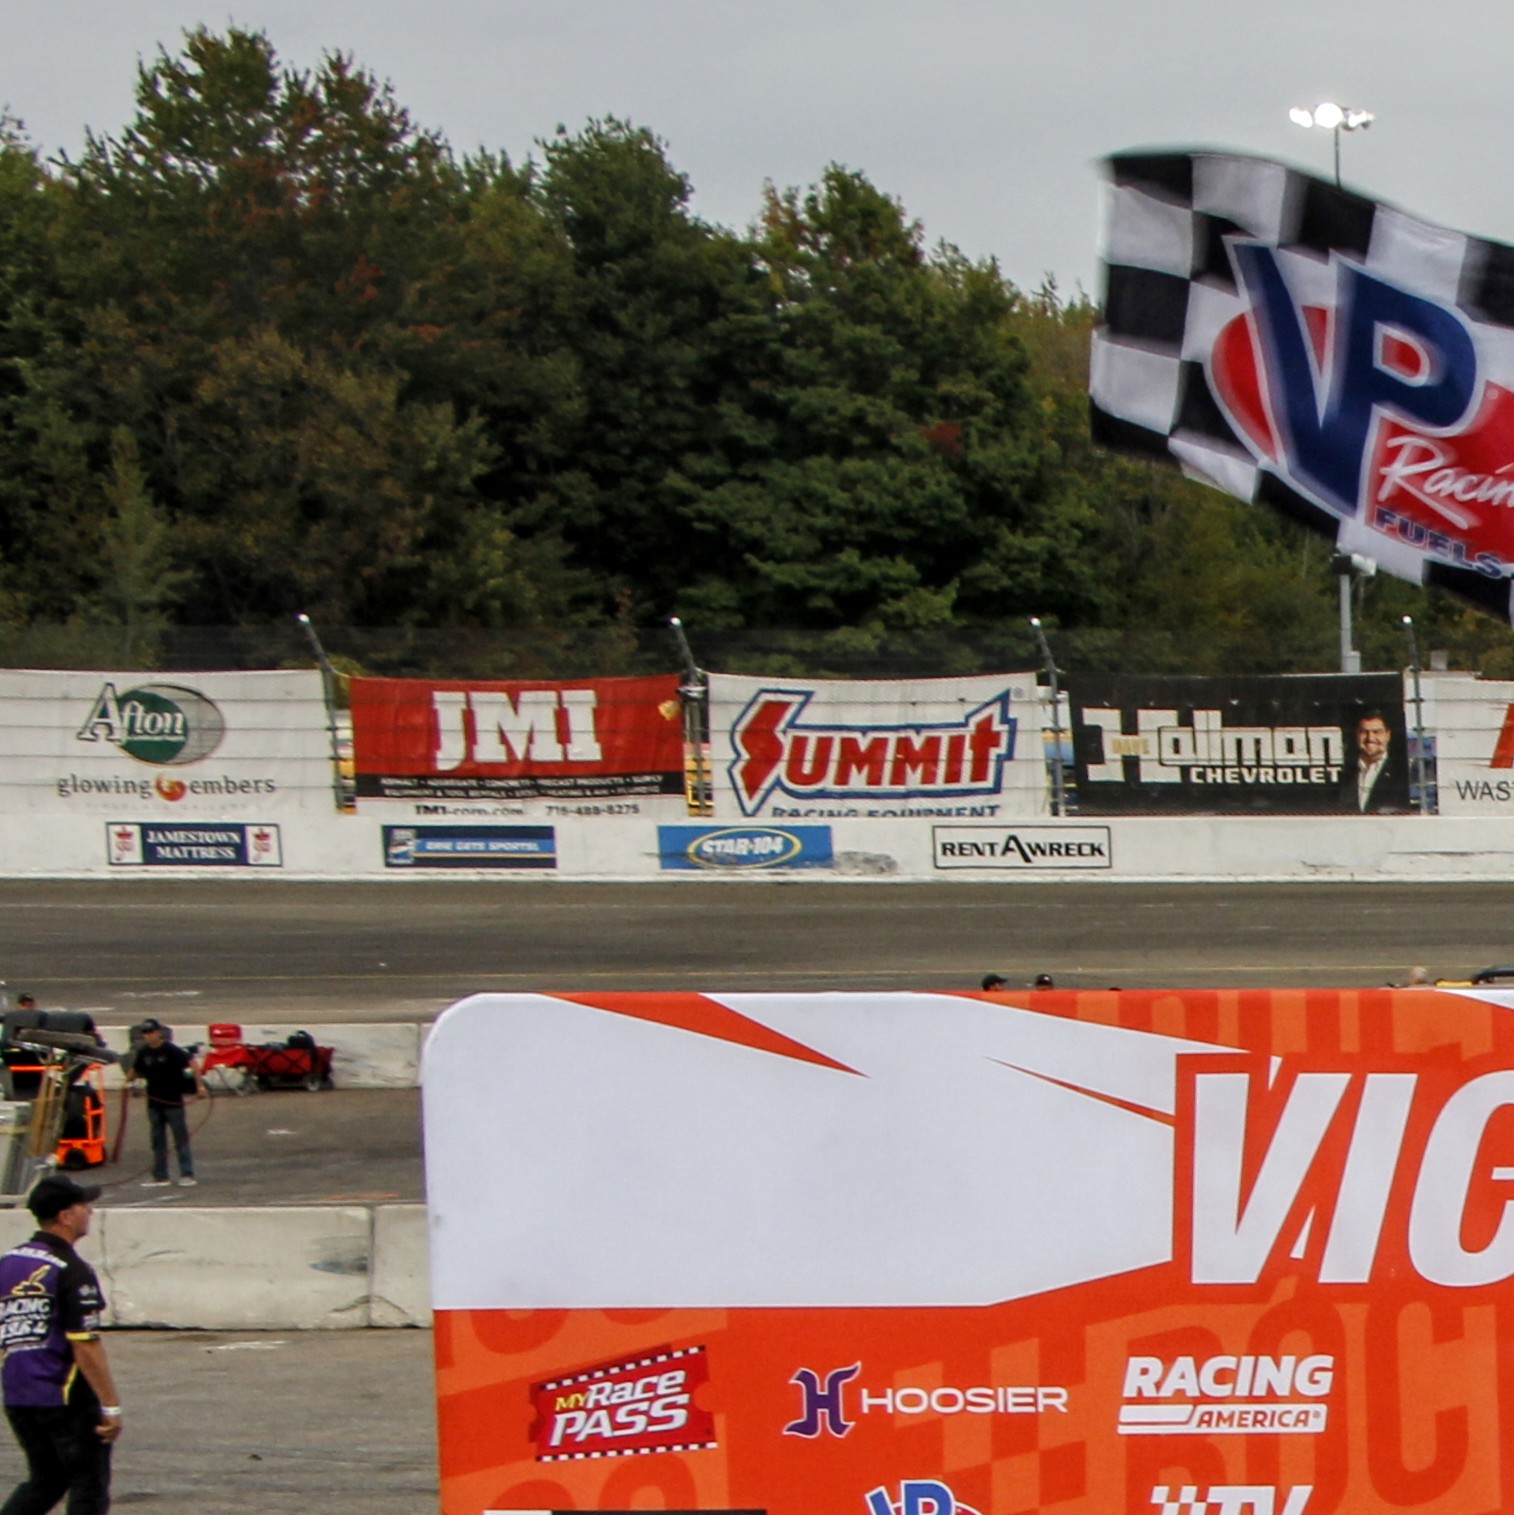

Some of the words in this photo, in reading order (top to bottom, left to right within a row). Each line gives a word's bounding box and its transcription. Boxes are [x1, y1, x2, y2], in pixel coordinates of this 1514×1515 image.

[1222, 234, 1478, 518] VP
[1373, 506, 1503, 579] FUELS
[76, 682, 187, 744] Afton
[432, 689, 603, 770] JMI
[57, 773, 154, 798] glowing
[190, 774, 277, 796] embers
[1190, 767, 1343, 784] CHEVROLET
[146, 830, 242, 844] JAMESTOWN
[156, 846, 237, 859] MATTRESS
[1122, 1355, 1334, 1397] RACING
[548, 1392, 691, 1447] PASS
[861, 1387, 1068, 1414] HOOSIER
